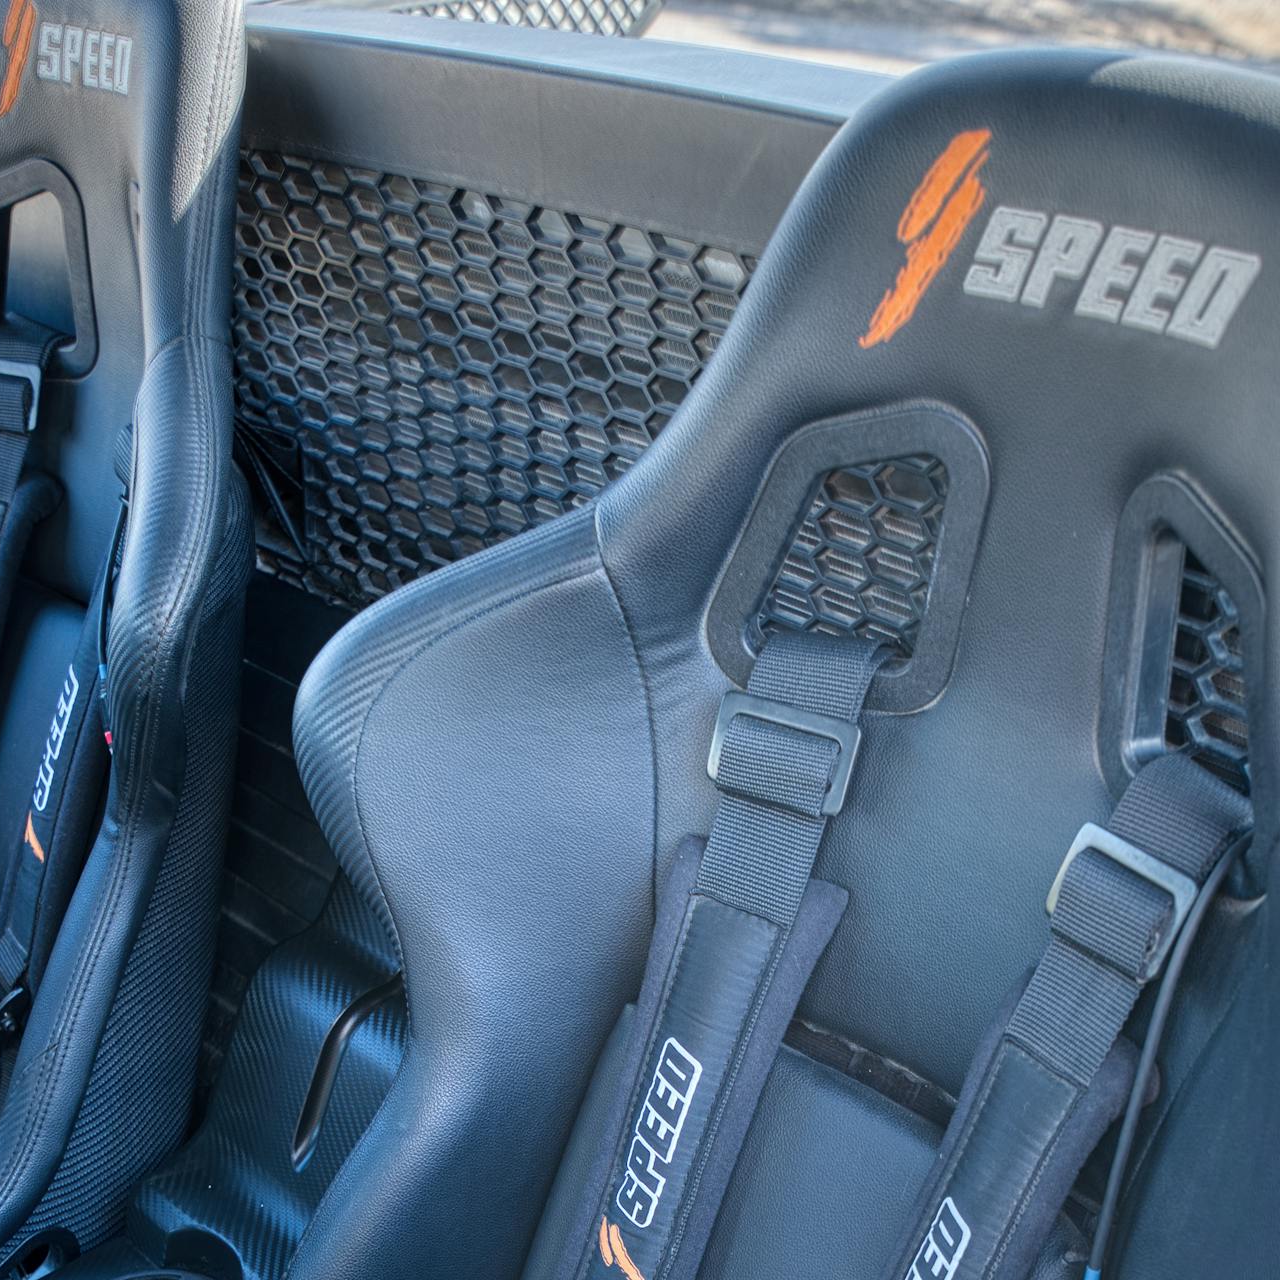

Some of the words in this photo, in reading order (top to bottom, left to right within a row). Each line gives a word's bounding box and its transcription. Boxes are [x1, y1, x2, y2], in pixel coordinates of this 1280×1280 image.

[37, 22, 133, 96] SPEED
[963, 206, 1262, 350] SPEED
[616, 1037, 703, 1228] SPEED
